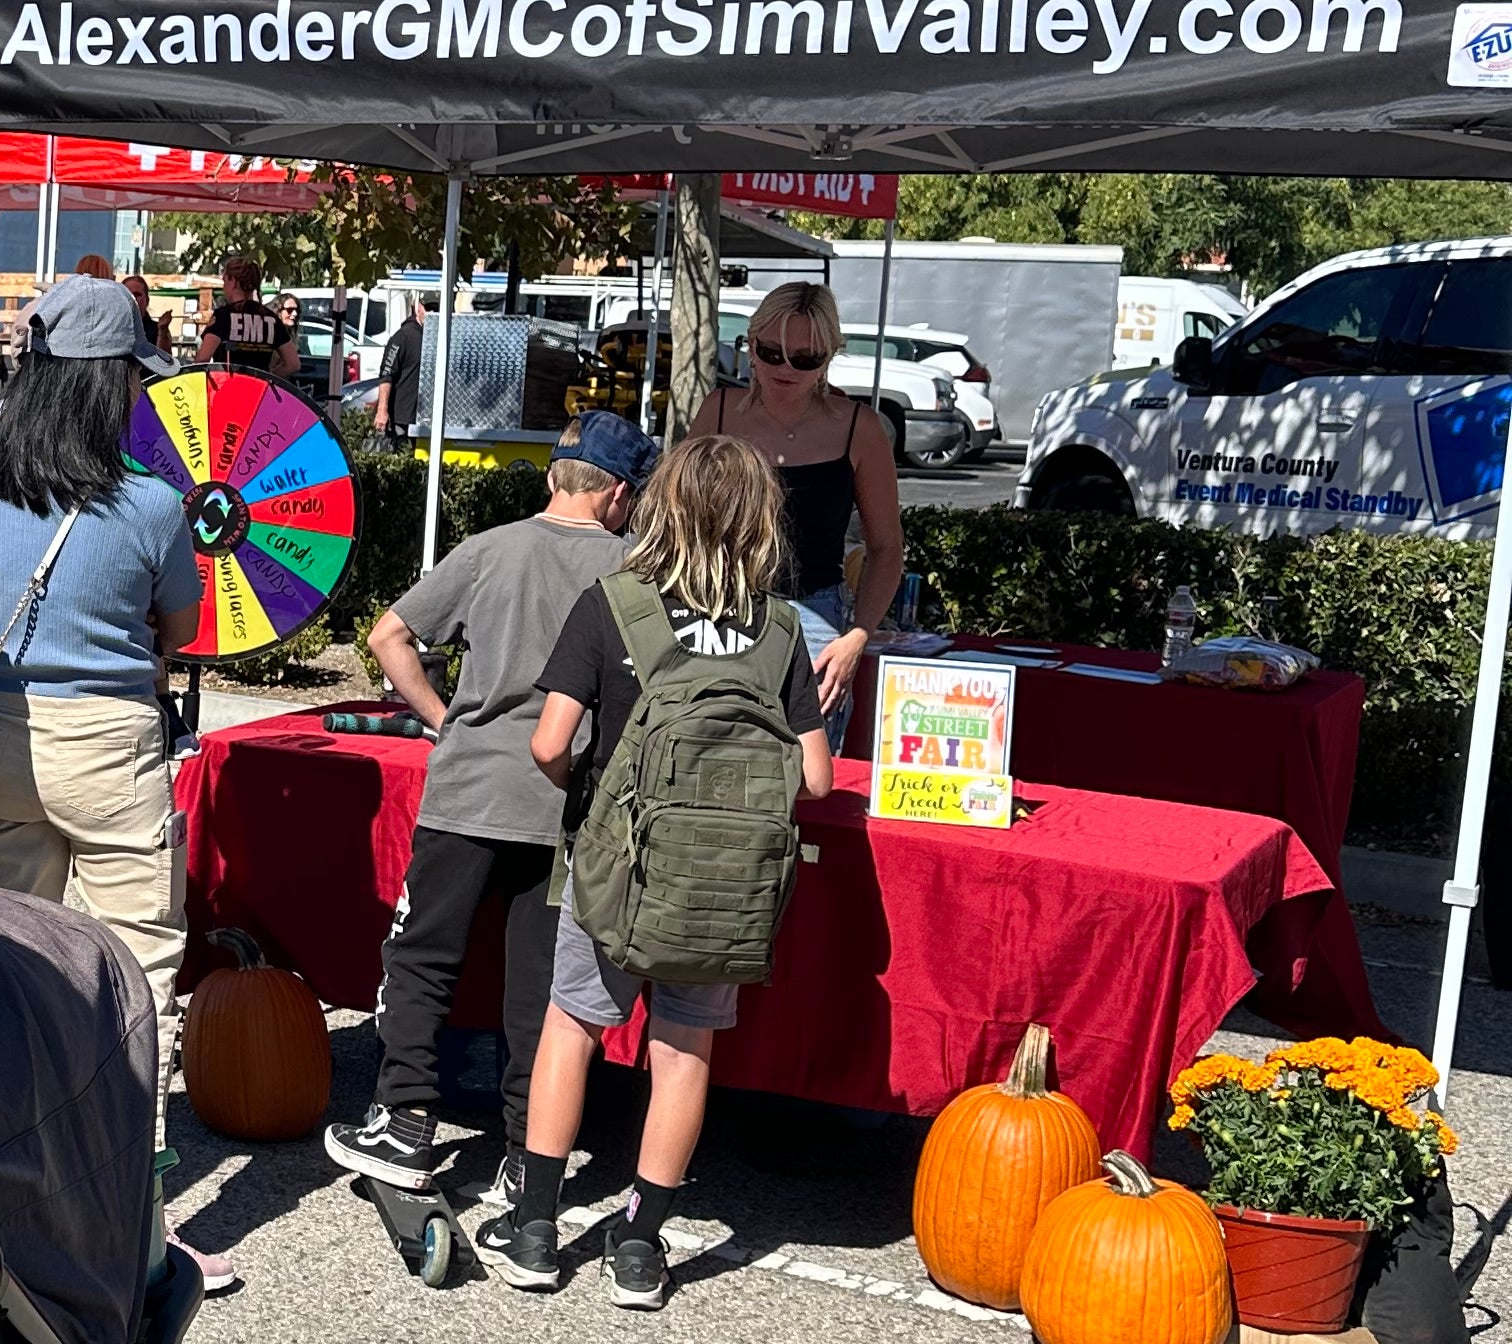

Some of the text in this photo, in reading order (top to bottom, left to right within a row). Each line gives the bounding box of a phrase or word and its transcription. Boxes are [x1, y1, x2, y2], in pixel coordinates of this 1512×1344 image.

[229, 312, 276, 345] EMT
[169, 385, 205, 470] sunglasses
[137, 439, 186, 486] CANDY
[217, 422, 245, 472] candy
[236, 421, 287, 477] CANDY
[1176, 449, 1340, 484] Ventura County
[270, 497, 325, 520] candy
[1175, 479, 1424, 522] Event Medical Standby
[245, 548, 298, 599] CANDY
[893, 671, 957, 697] THANK
[922, 717, 987, 737] STREET
[899, 735, 987, 770] FAIR
[882, 773, 935, 793] Trick
[940, 782, 962, 795] or
[889, 791, 949, 811] Treat
